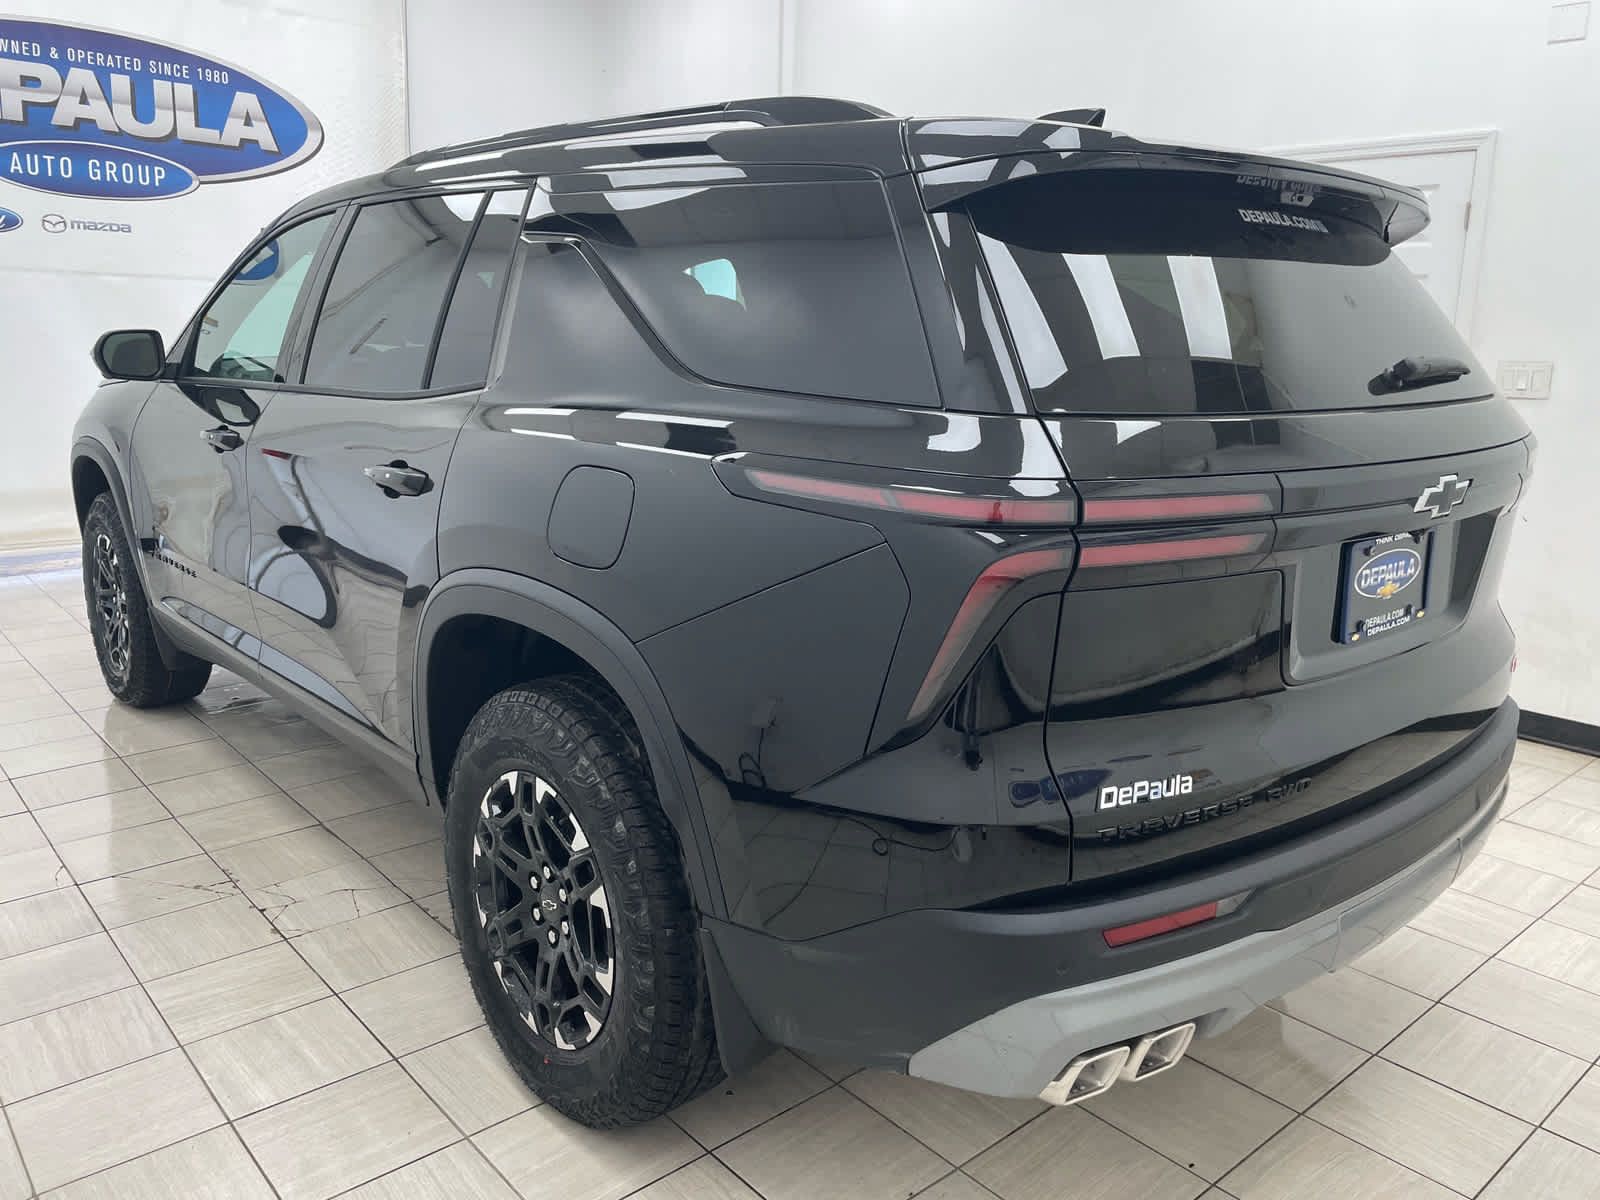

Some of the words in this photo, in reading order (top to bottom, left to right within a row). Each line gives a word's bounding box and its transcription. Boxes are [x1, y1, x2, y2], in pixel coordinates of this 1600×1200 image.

[49, 46, 59, 59] &
[67, 47, 142, 72] OPERATED
[149, 60, 190, 79] SINCE
[197, 67, 229, 85] 1980
[10, 152, 73, 178] AUTO
[88, 159, 166, 186] GROUP
[1238, 208, 1321, 232] DEPAULA.COM
[1361, 558, 1415, 588] DEPAULA
[1367, 615, 1410, 636] DEPAULA.COM
[1100, 774, 1193, 810] DePaula
[1096, 794, 1256, 842] TRAVERSE
